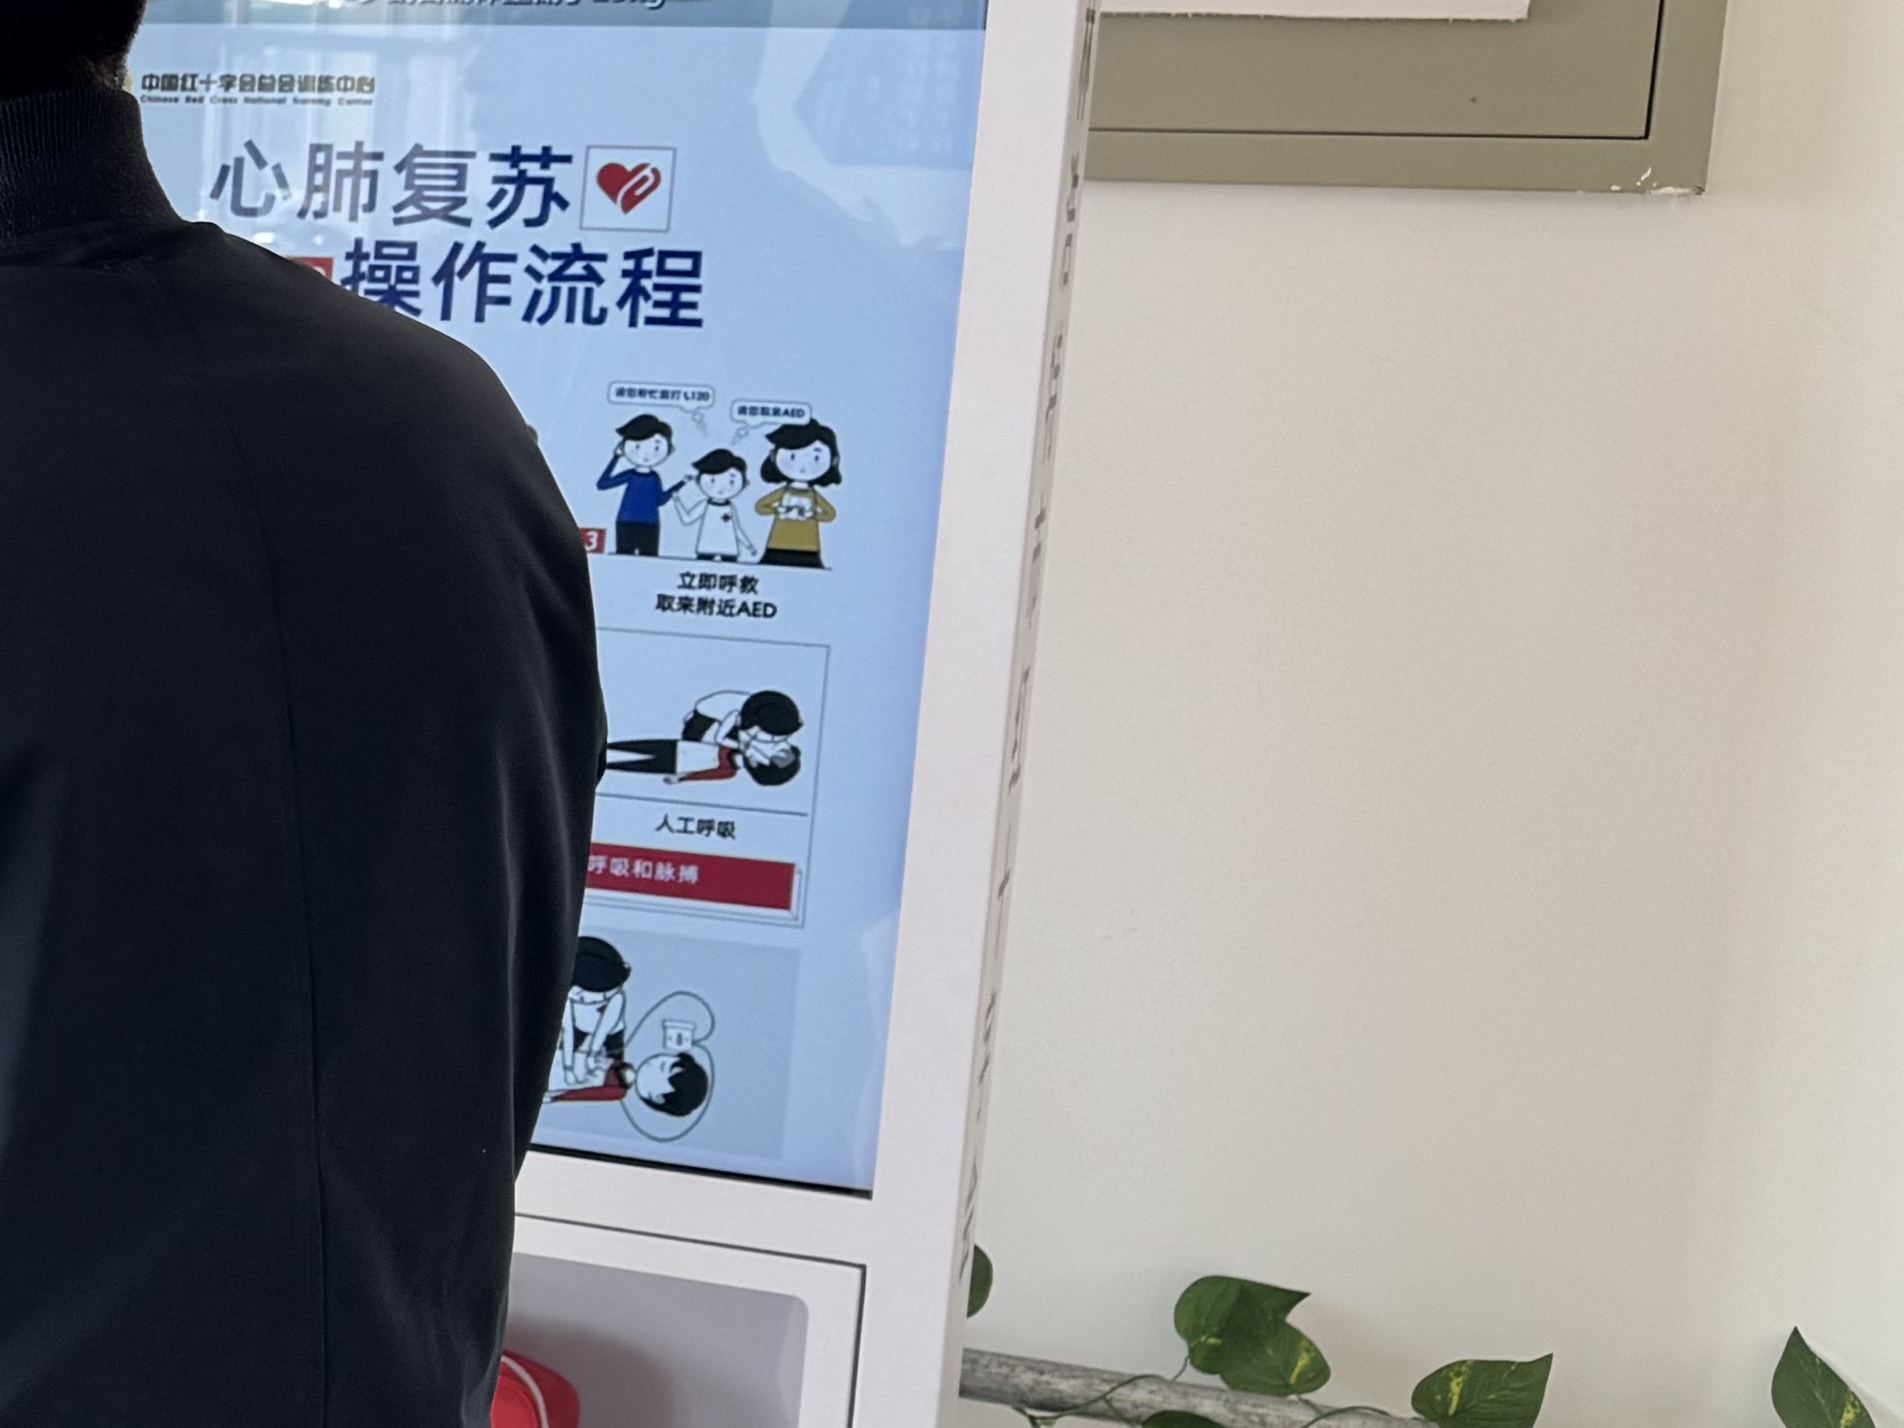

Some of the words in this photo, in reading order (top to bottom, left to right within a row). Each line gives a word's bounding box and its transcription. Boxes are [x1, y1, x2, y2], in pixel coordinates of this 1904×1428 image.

[209, 140, 575, 230] 心肺复苏
[339, 238, 707, 329] 操作流程
[677, 571, 759, 596] 立即呼救
[655, 592, 778, 620] 取来附近AED
[654, 813, 737, 840] 人工呼吸
